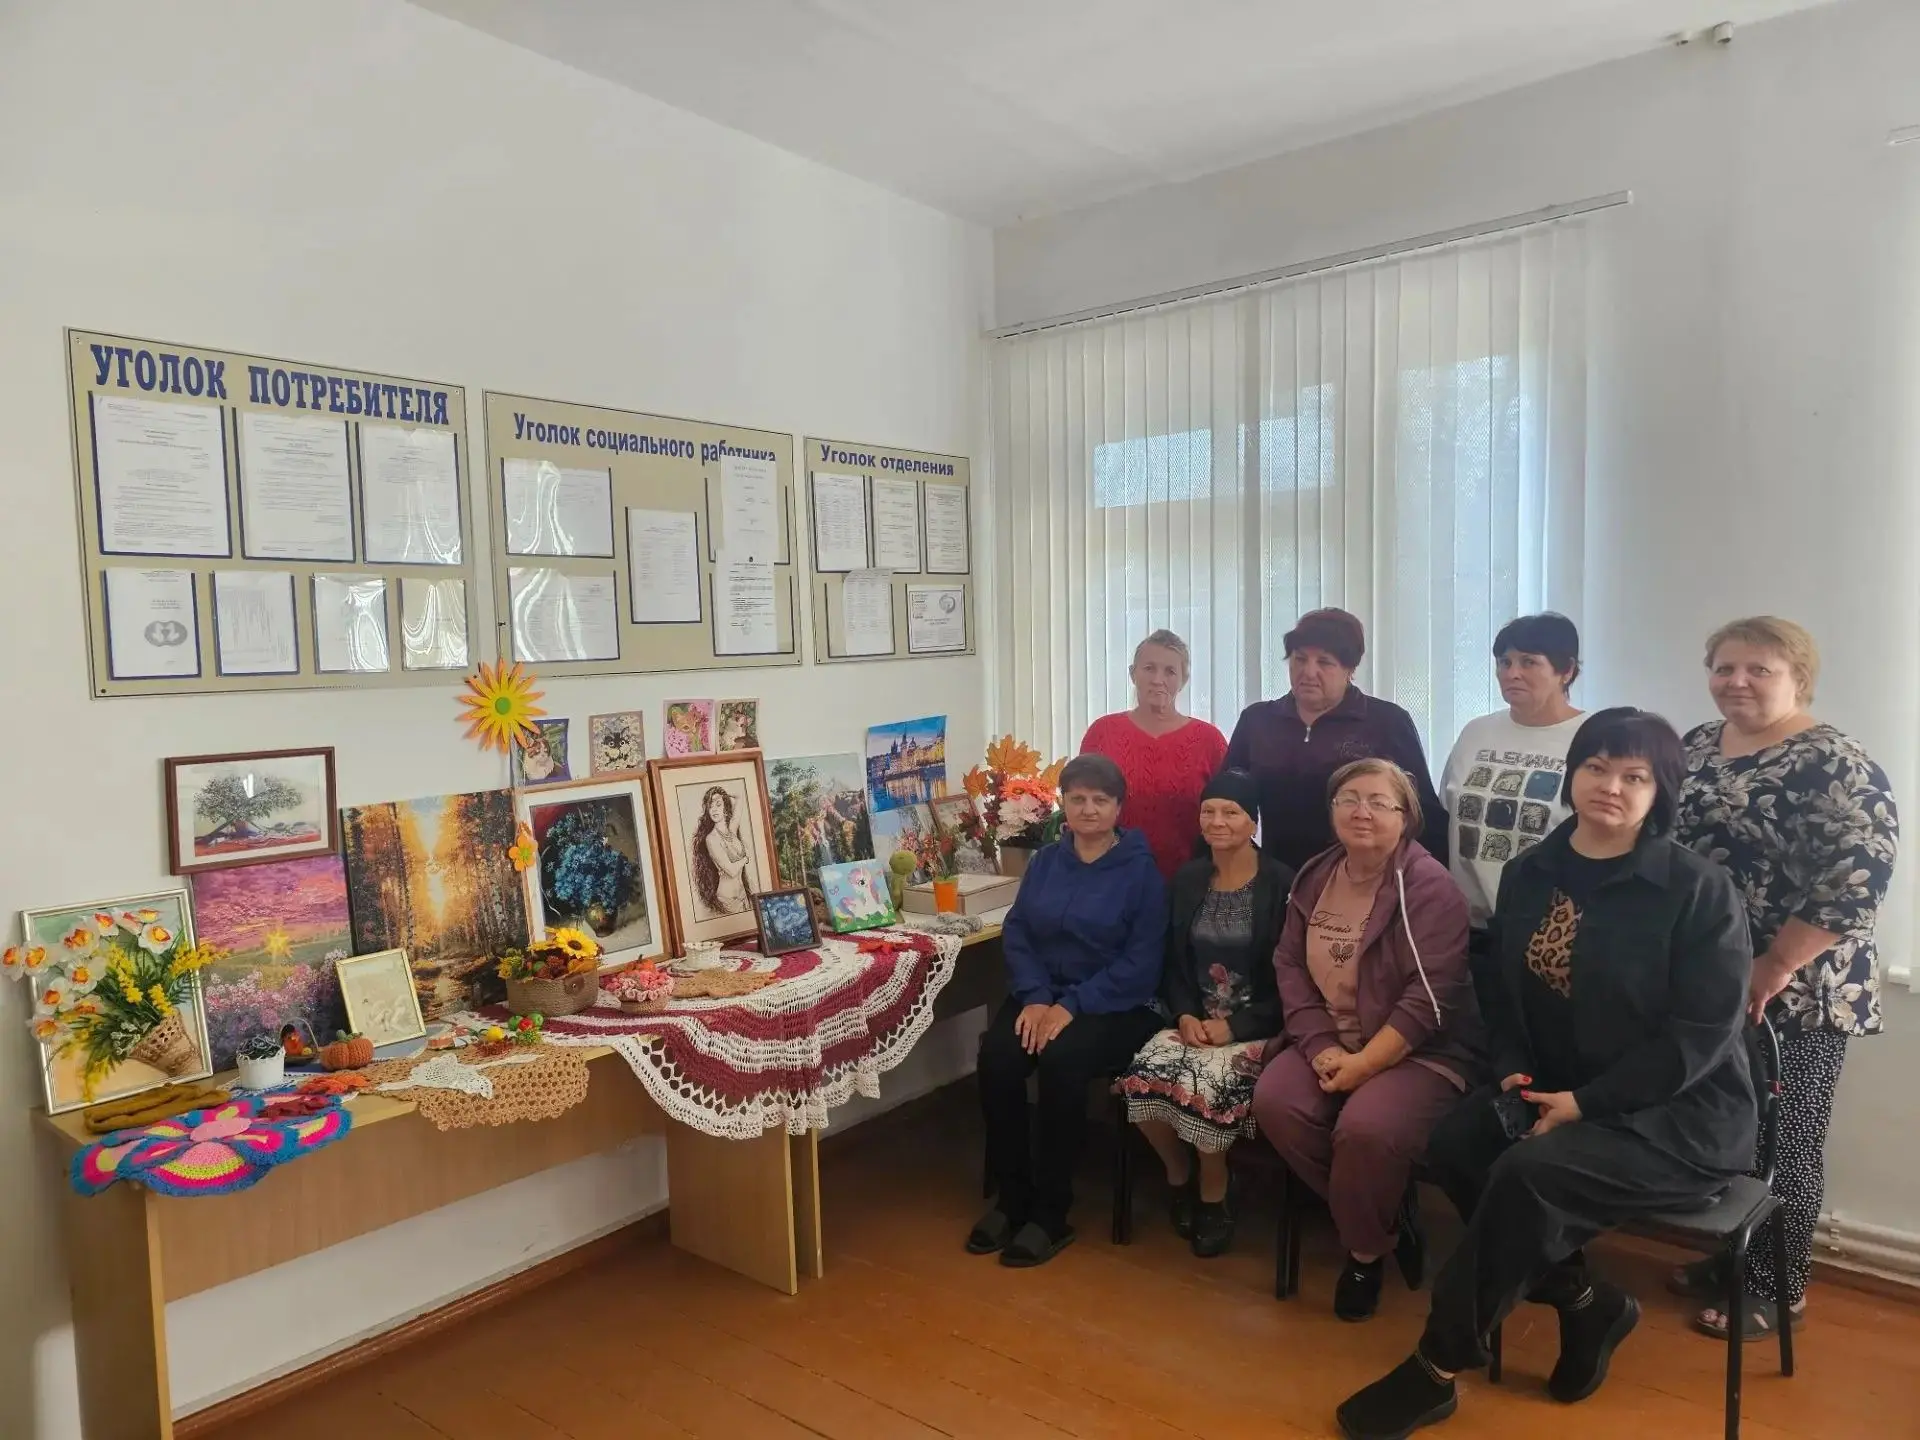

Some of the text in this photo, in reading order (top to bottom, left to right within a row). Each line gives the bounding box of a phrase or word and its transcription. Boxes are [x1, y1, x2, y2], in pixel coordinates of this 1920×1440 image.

[90, 344, 450, 426] УГОЛОК ПОТРЕБИТЕЛЯ
[513, 412, 581, 446] Уголок
[586, 428, 695, 460] социального
[820, 443, 954, 476] Уголок отделения
[1308, 910, 1352, 934] Tennis
